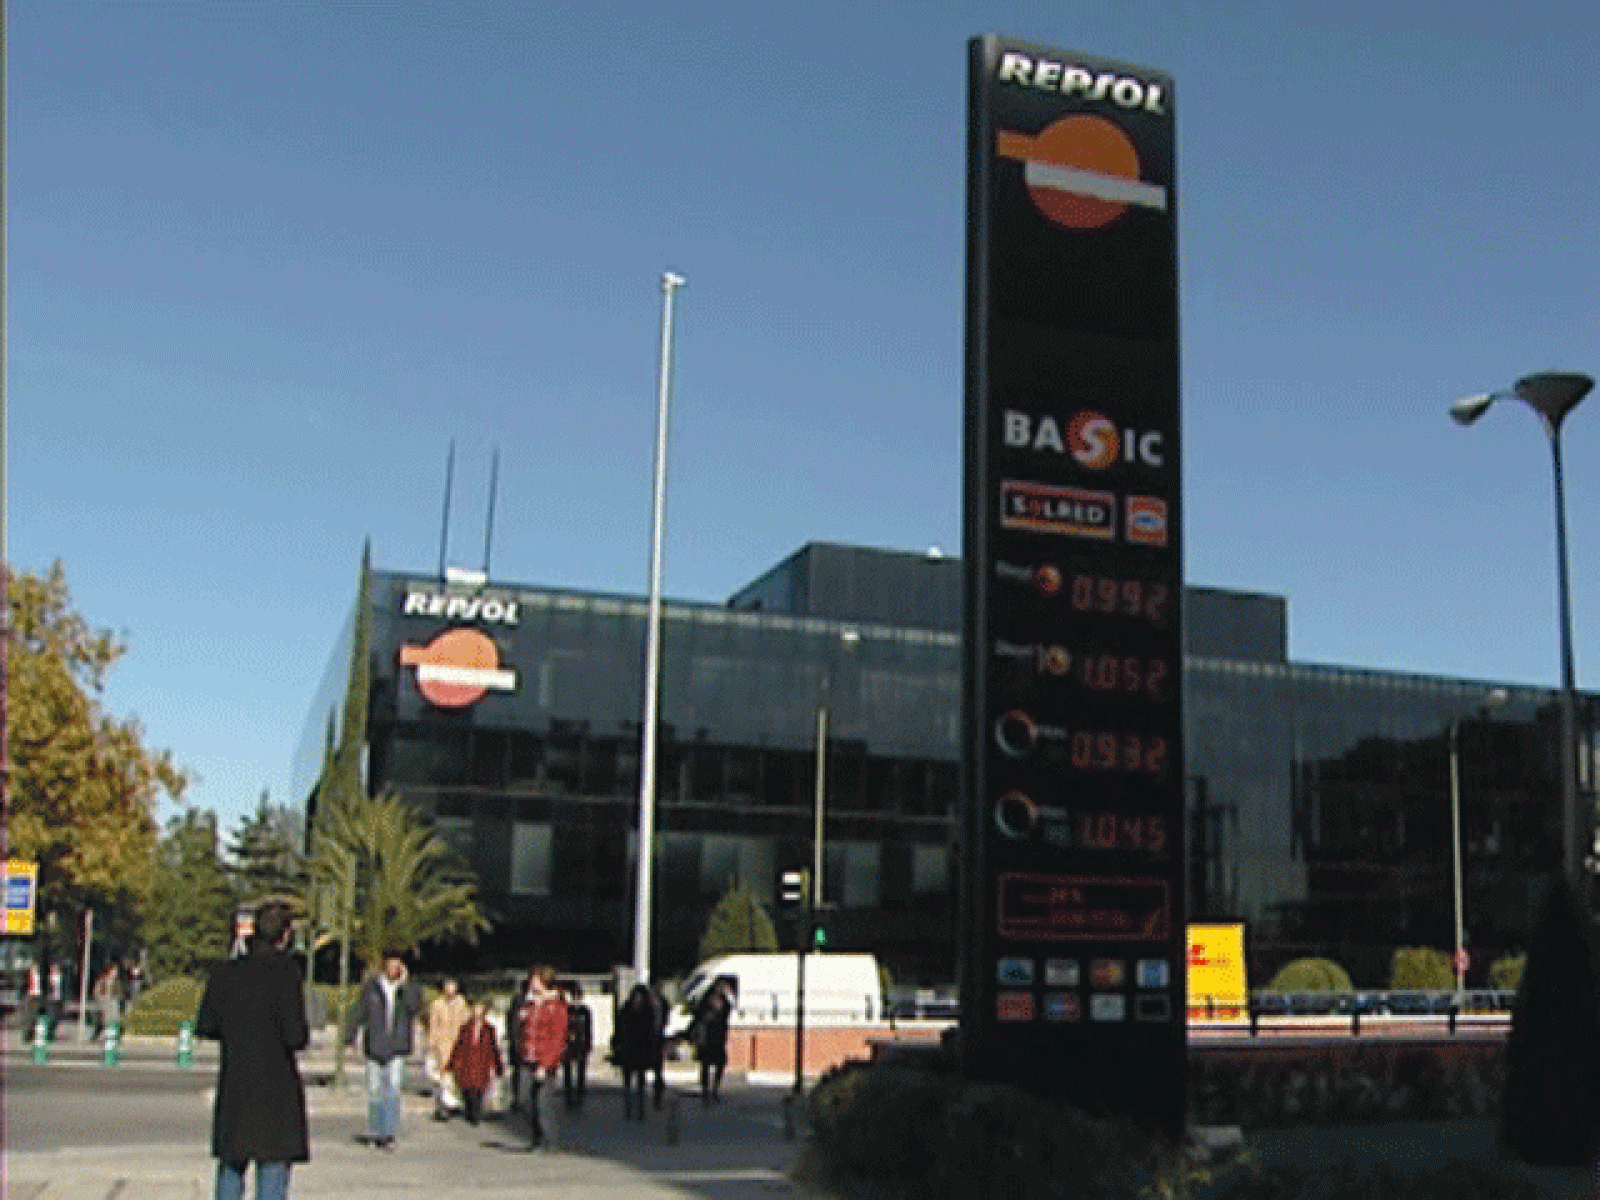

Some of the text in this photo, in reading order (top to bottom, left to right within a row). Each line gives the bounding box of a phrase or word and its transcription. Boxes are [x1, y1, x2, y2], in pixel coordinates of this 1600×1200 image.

[1000, 52, 1165, 114] REPSOL
[1004, 410, 1164, 468] BASIC
[404, 592, 518, 624] REPSOL
